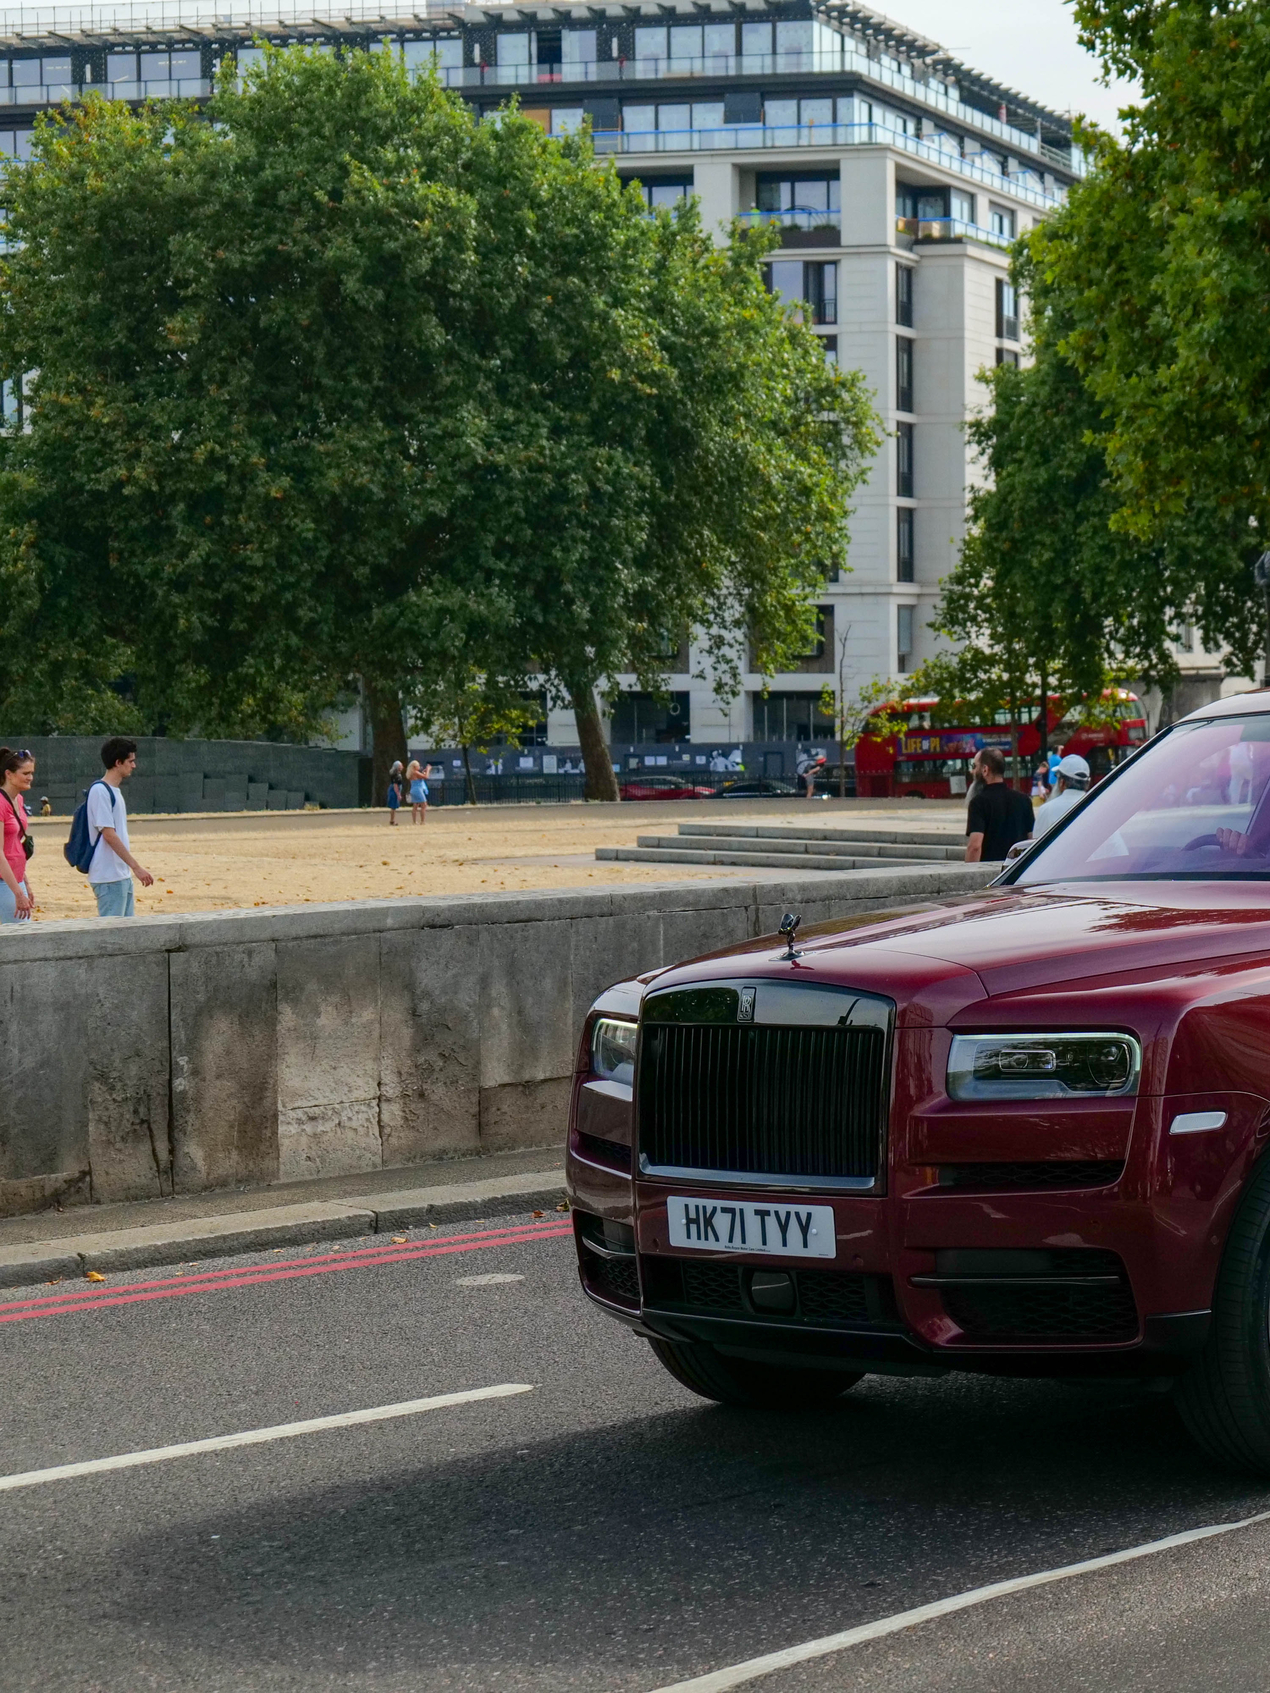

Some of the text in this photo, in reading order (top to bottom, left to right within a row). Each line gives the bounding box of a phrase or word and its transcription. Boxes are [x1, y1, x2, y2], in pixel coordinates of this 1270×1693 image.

[902, 738, 922, 753] LIFE
[930, 737, 940, 753] PI
[684, 1203, 812, 1249] HK71 TYY
